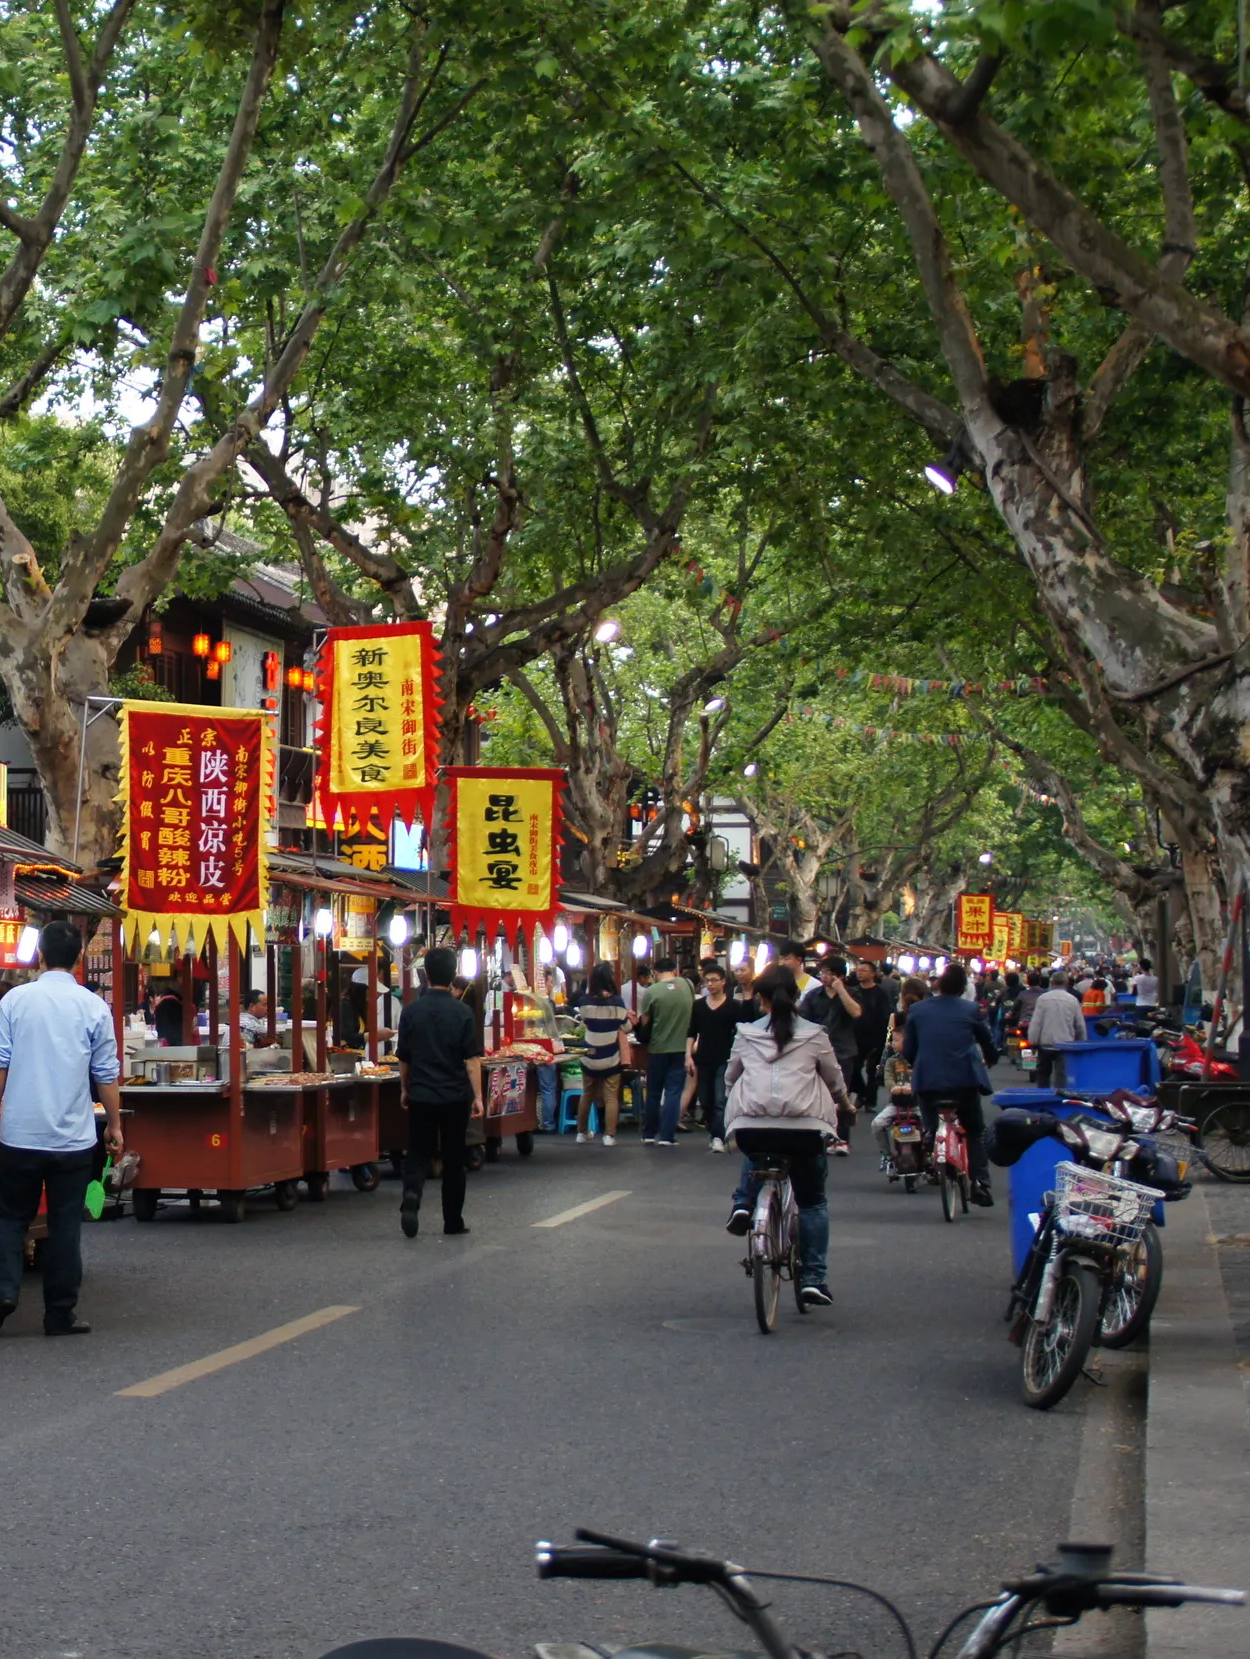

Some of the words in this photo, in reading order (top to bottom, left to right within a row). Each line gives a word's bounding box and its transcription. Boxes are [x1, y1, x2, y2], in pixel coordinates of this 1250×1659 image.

[177, 728, 218, 747] 正宗
[351, 647, 392, 783] 新奥尔良美食
[400, 679, 418, 757] 南宋御街
[140, 741, 156, 851] 以防假冒
[157, 747, 193, 887] 重庆八哥酸辣粉
[198, 749, 229, 888] 陕西凉皮
[231, 745, 249, 876] 南宋御街小吃5号
[479, 794, 525, 890] 昆虫宴
[168, 892, 233, 906] 欢迎品尝
[211, 1134, 221, 1148] 6
